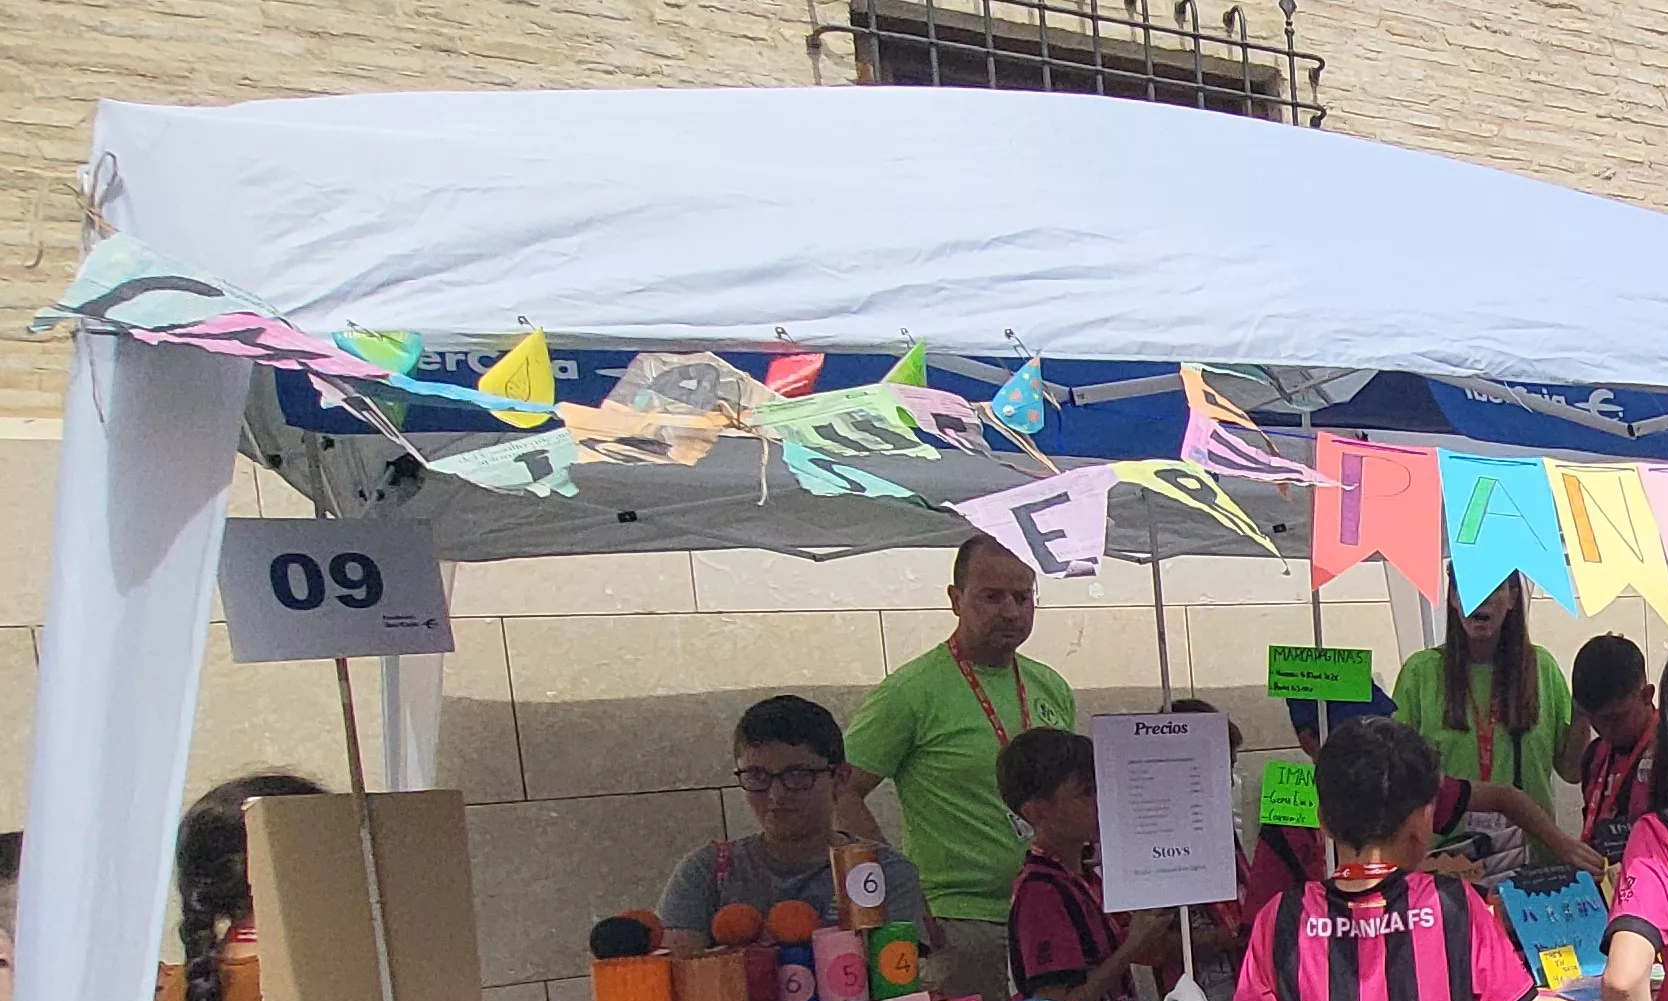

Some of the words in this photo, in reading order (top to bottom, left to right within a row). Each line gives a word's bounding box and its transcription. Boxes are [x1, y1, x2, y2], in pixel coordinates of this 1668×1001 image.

[270, 551, 384, 611] 09
[1133, 721, 1189, 736] Precios
[863, 871, 879, 895] 6
[1306, 917, 1333, 938] CD
[1336, 911, 1405, 938] PANIZA
[1406, 907, 1435, 930] FS
[894, 951, 911, 973] 4
[786, 972, 802, 994] 6
[843, 964, 859, 987] 5
